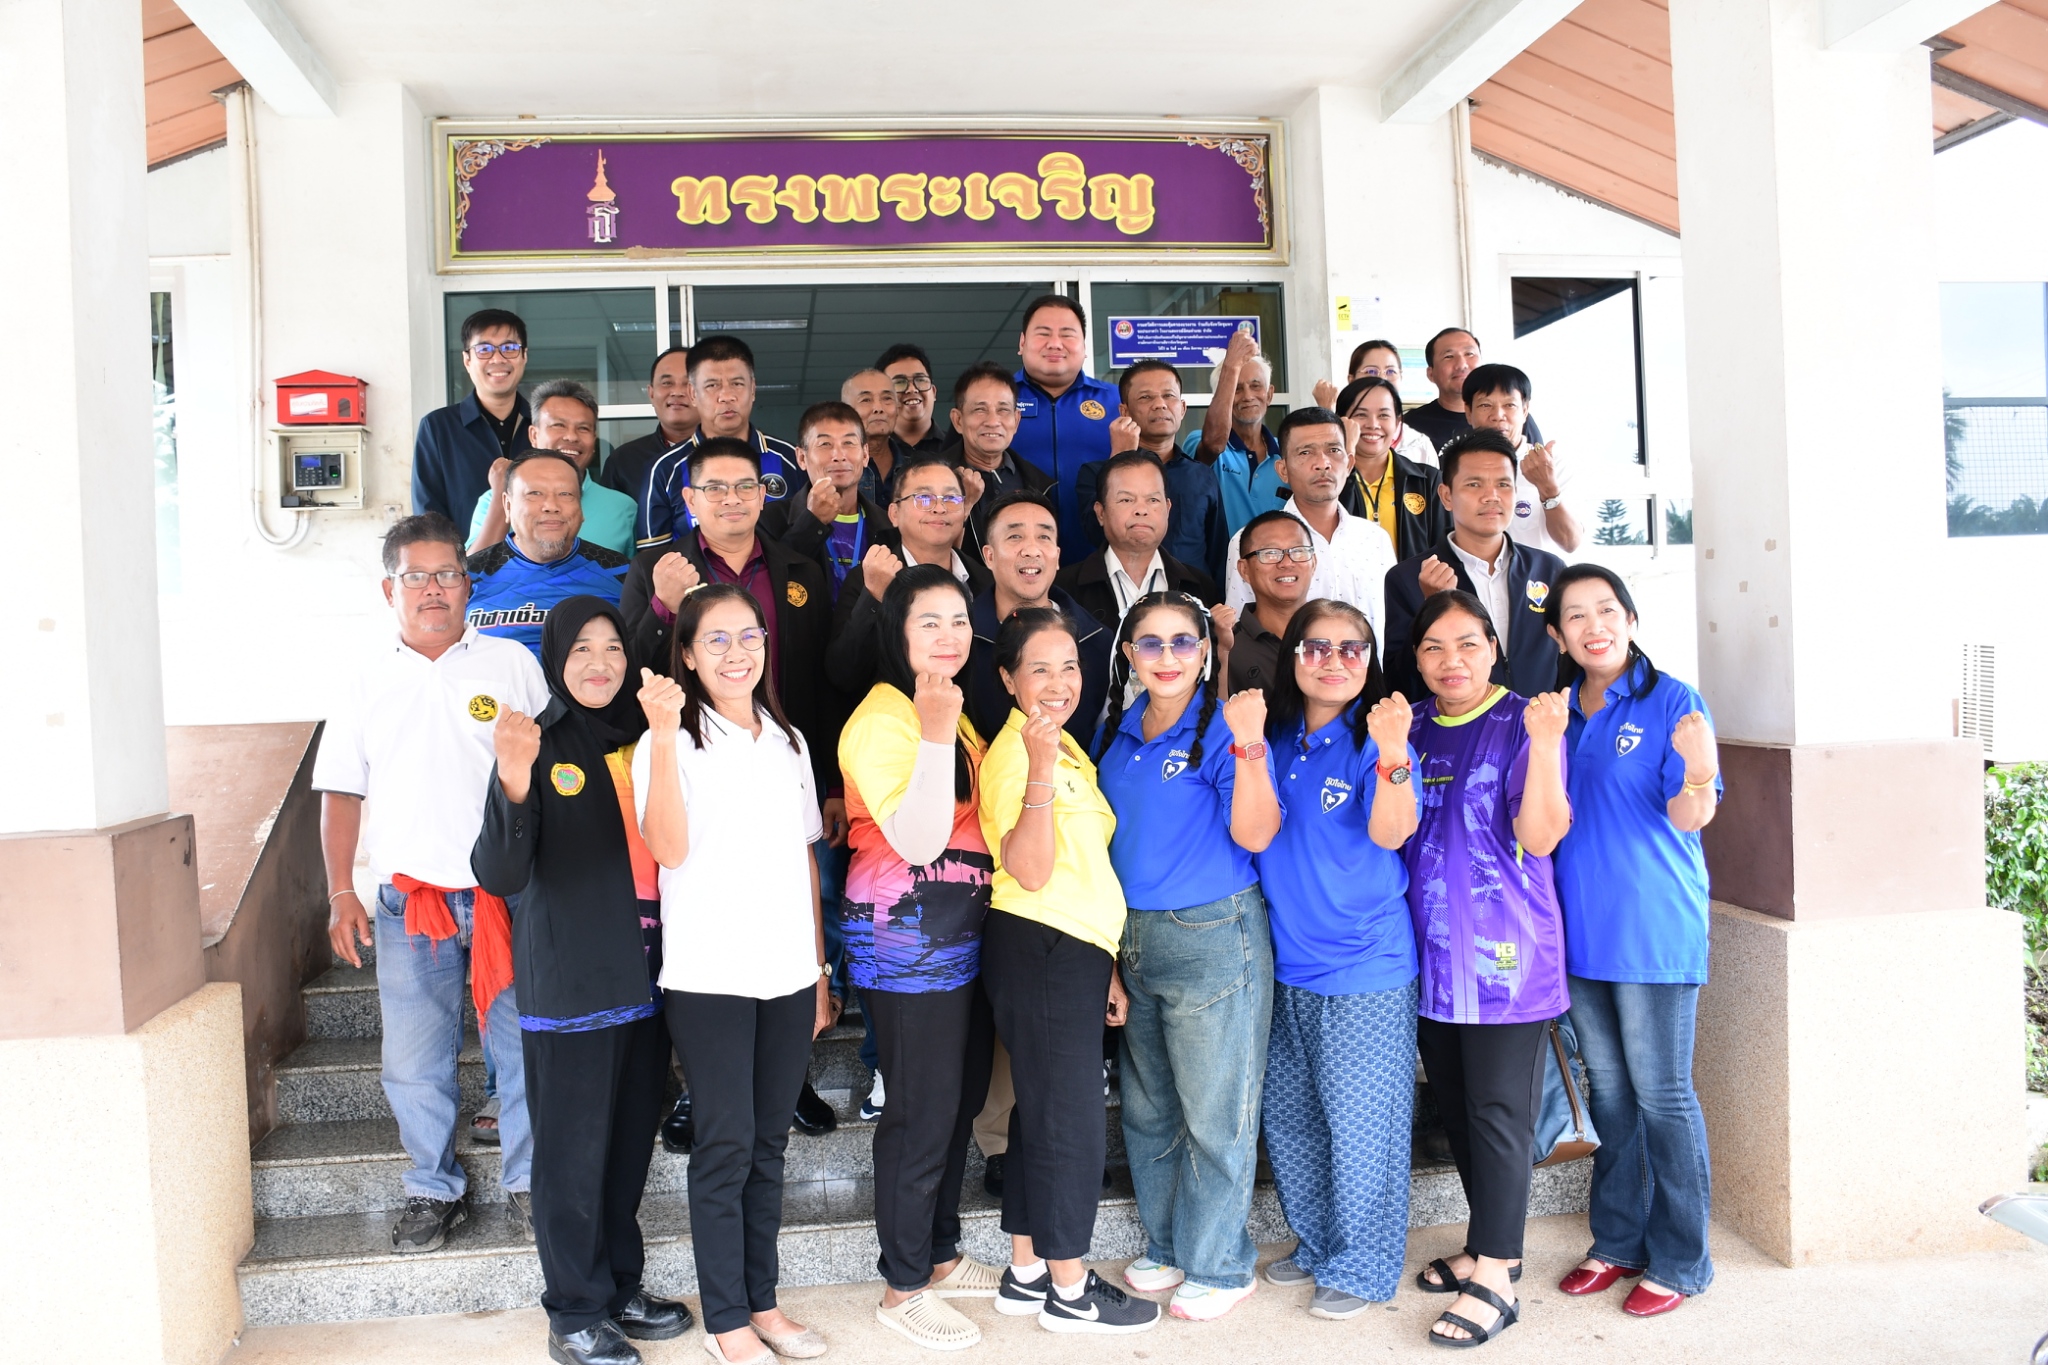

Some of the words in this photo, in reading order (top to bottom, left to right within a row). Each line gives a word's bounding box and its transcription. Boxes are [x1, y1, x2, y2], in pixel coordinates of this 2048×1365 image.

[671, 151, 1155, 235] ทรงพระเจริญ
[469, 602, 552, 628] กีฬาเชื่อ
